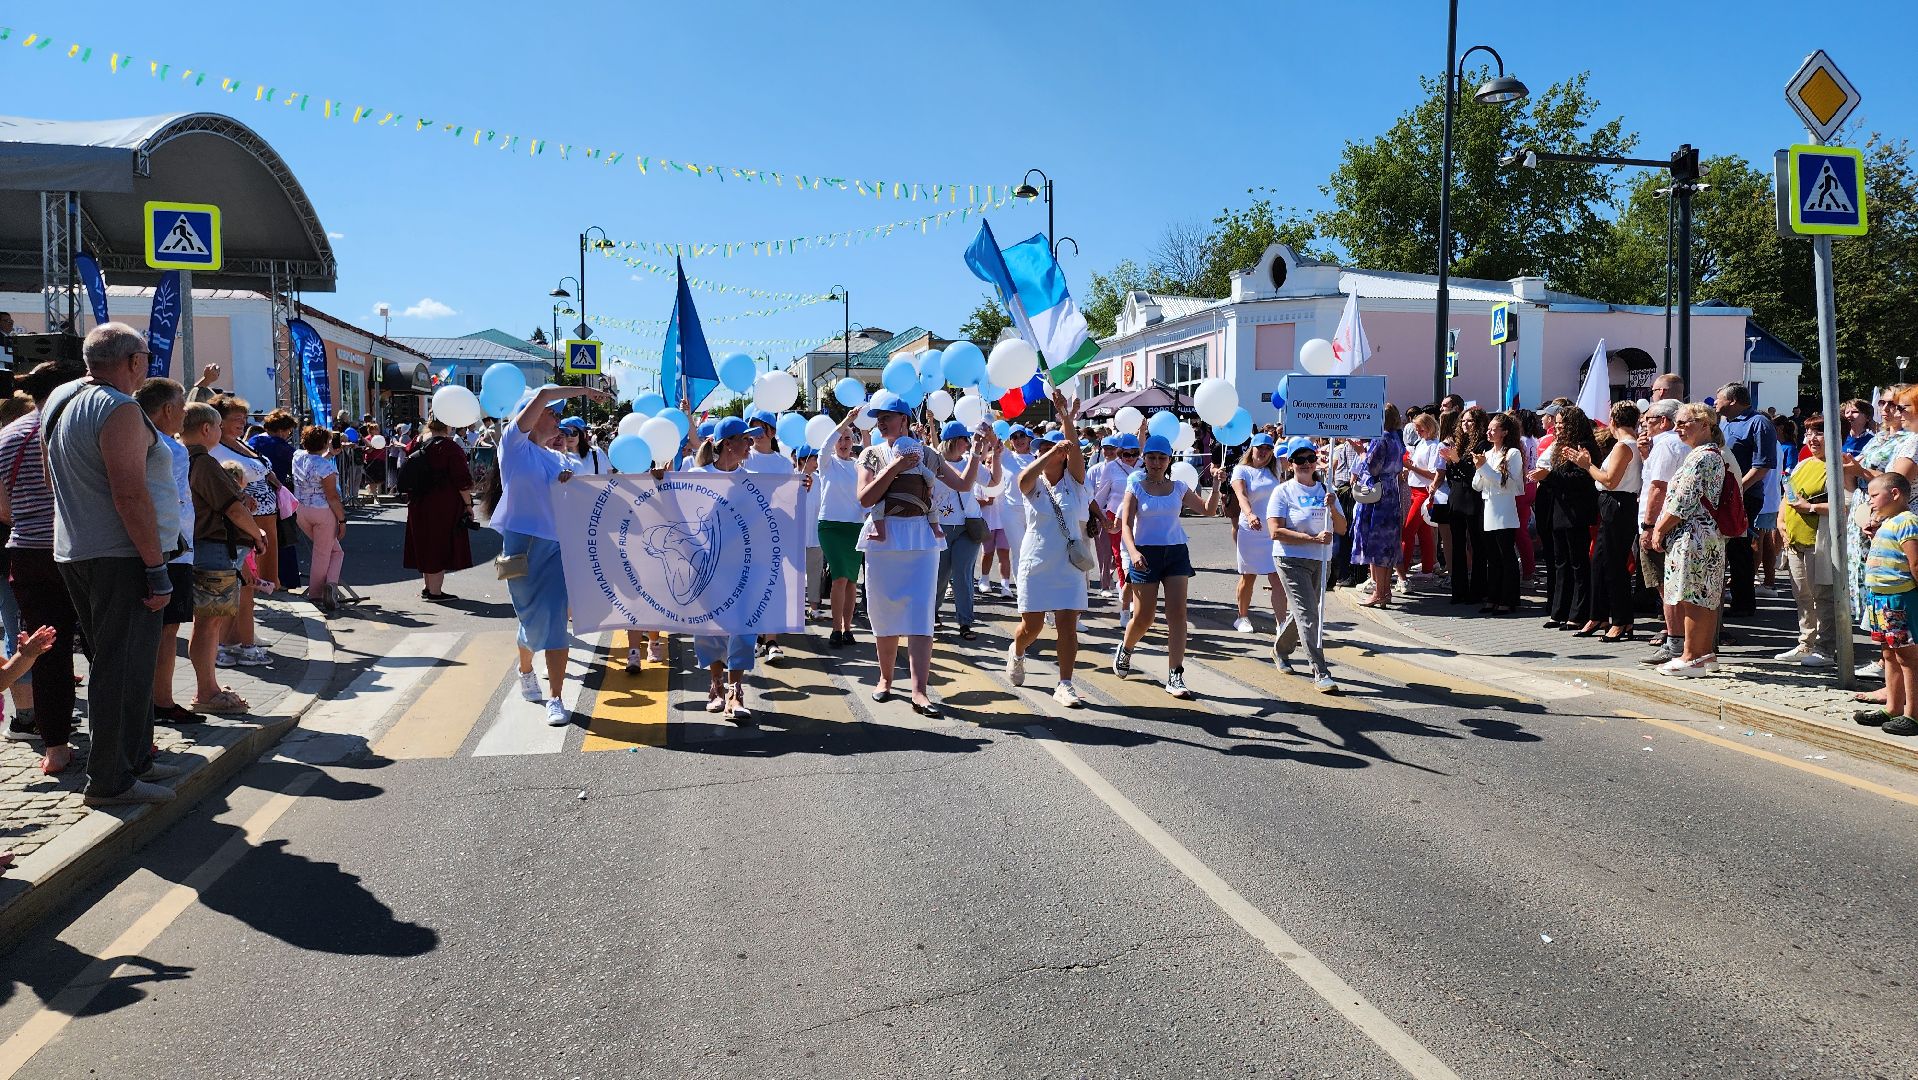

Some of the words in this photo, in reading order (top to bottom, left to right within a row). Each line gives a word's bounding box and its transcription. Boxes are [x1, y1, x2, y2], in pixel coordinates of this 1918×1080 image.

[1292, 400, 1347, 410] Общественная
[1344, 413, 1371, 421] округа
[1319, 422, 1348, 431] Кашира
[634, 489, 655, 506] СОЮЗ
[656, 482, 693, 492] ЖЕНЩИН
[696, 485, 728, 507] РОССИИ
[588, 479, 618, 536] ОТДЕЛЕНИЕ
[742, 479, 780, 543] ГОРОДСКОГО
[619, 519, 630, 546] RUSSIA
[620, 549, 627, 559] OF
[768, 547, 780, 586] ОКРУГА
[588, 540, 638, 625] МУНИЦИПАЛЬНОЕ
[622, 561, 638, 586] UNION
[732, 565, 750, 598] FEMMES
[713, 606, 724, 616] LA
[723, 597, 735, 610] DE
[745, 588, 773, 627] КАШИРА
[666, 611, 679, 622] THE
[688, 612, 713, 624] RUSSIE
